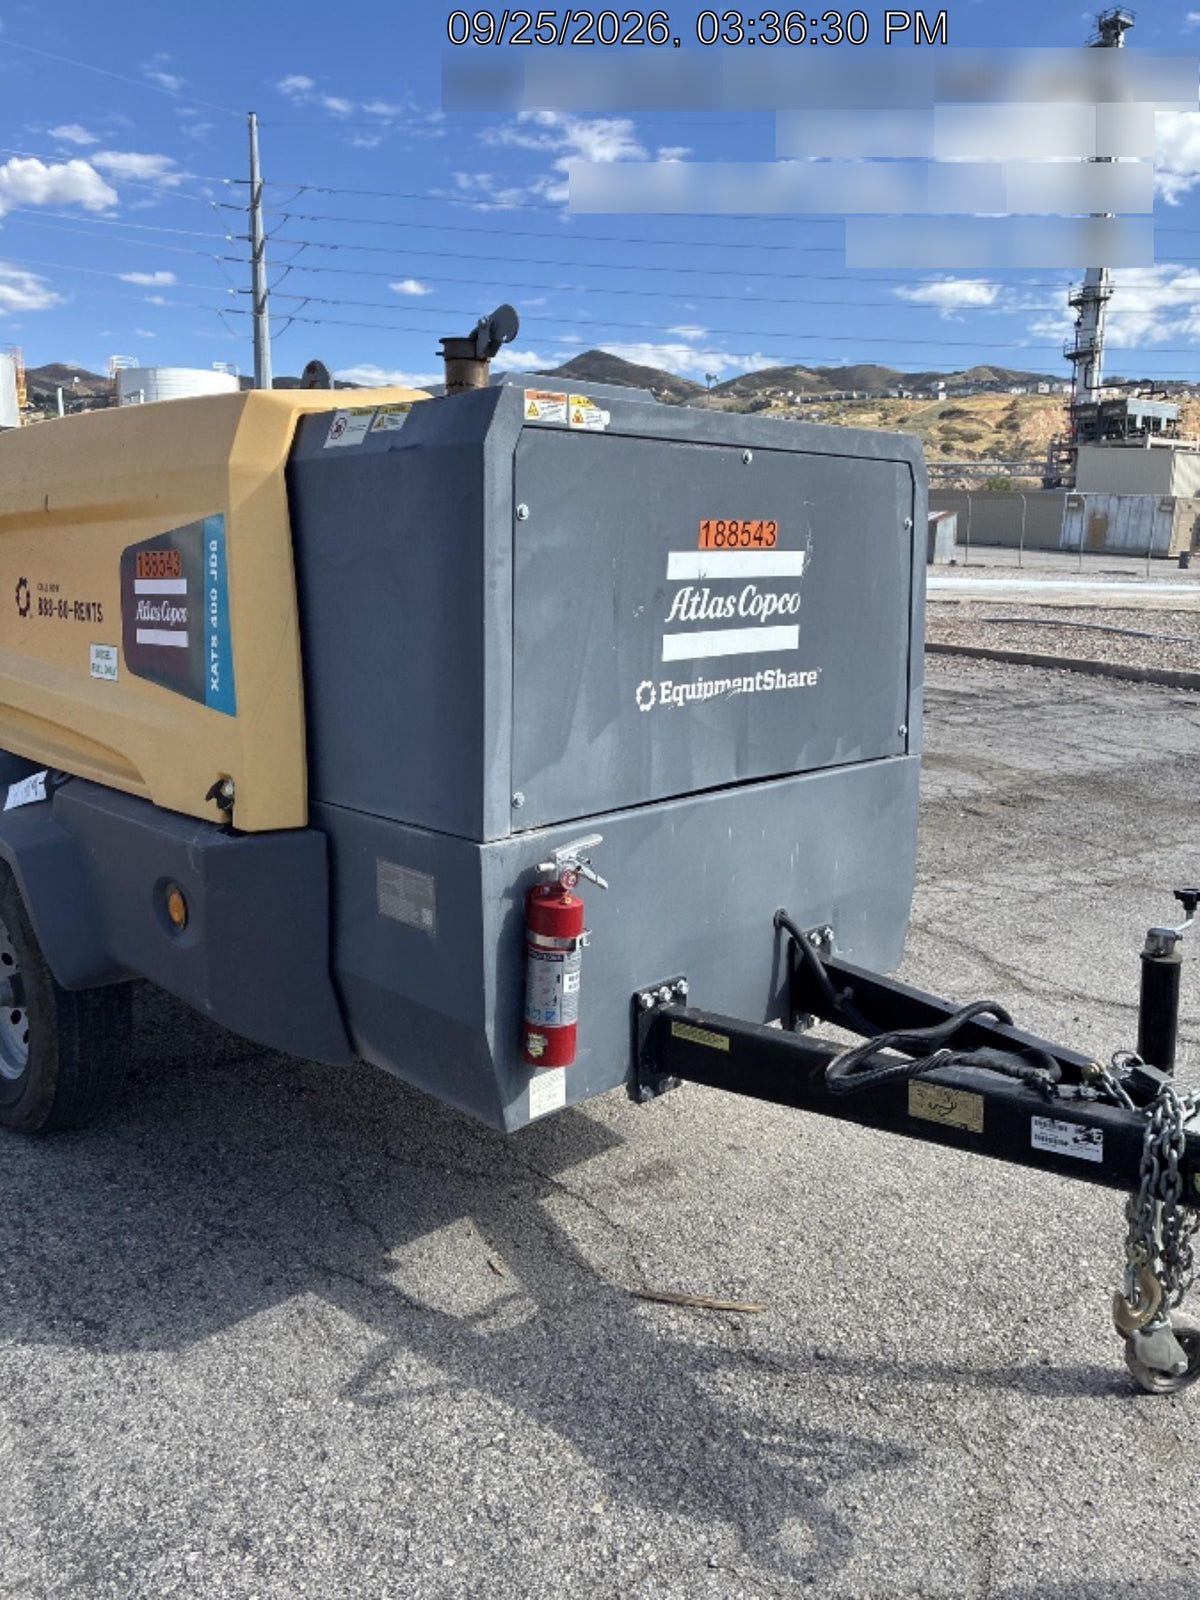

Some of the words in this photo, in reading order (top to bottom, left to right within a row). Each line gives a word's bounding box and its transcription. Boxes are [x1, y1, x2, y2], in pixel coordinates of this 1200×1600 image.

[701, 520, 777, 547] 188543
[137, 551, 180, 577] 188543
[210, 588, 218, 628] 400
[659, 668, 819, 707] EquipmentShare
